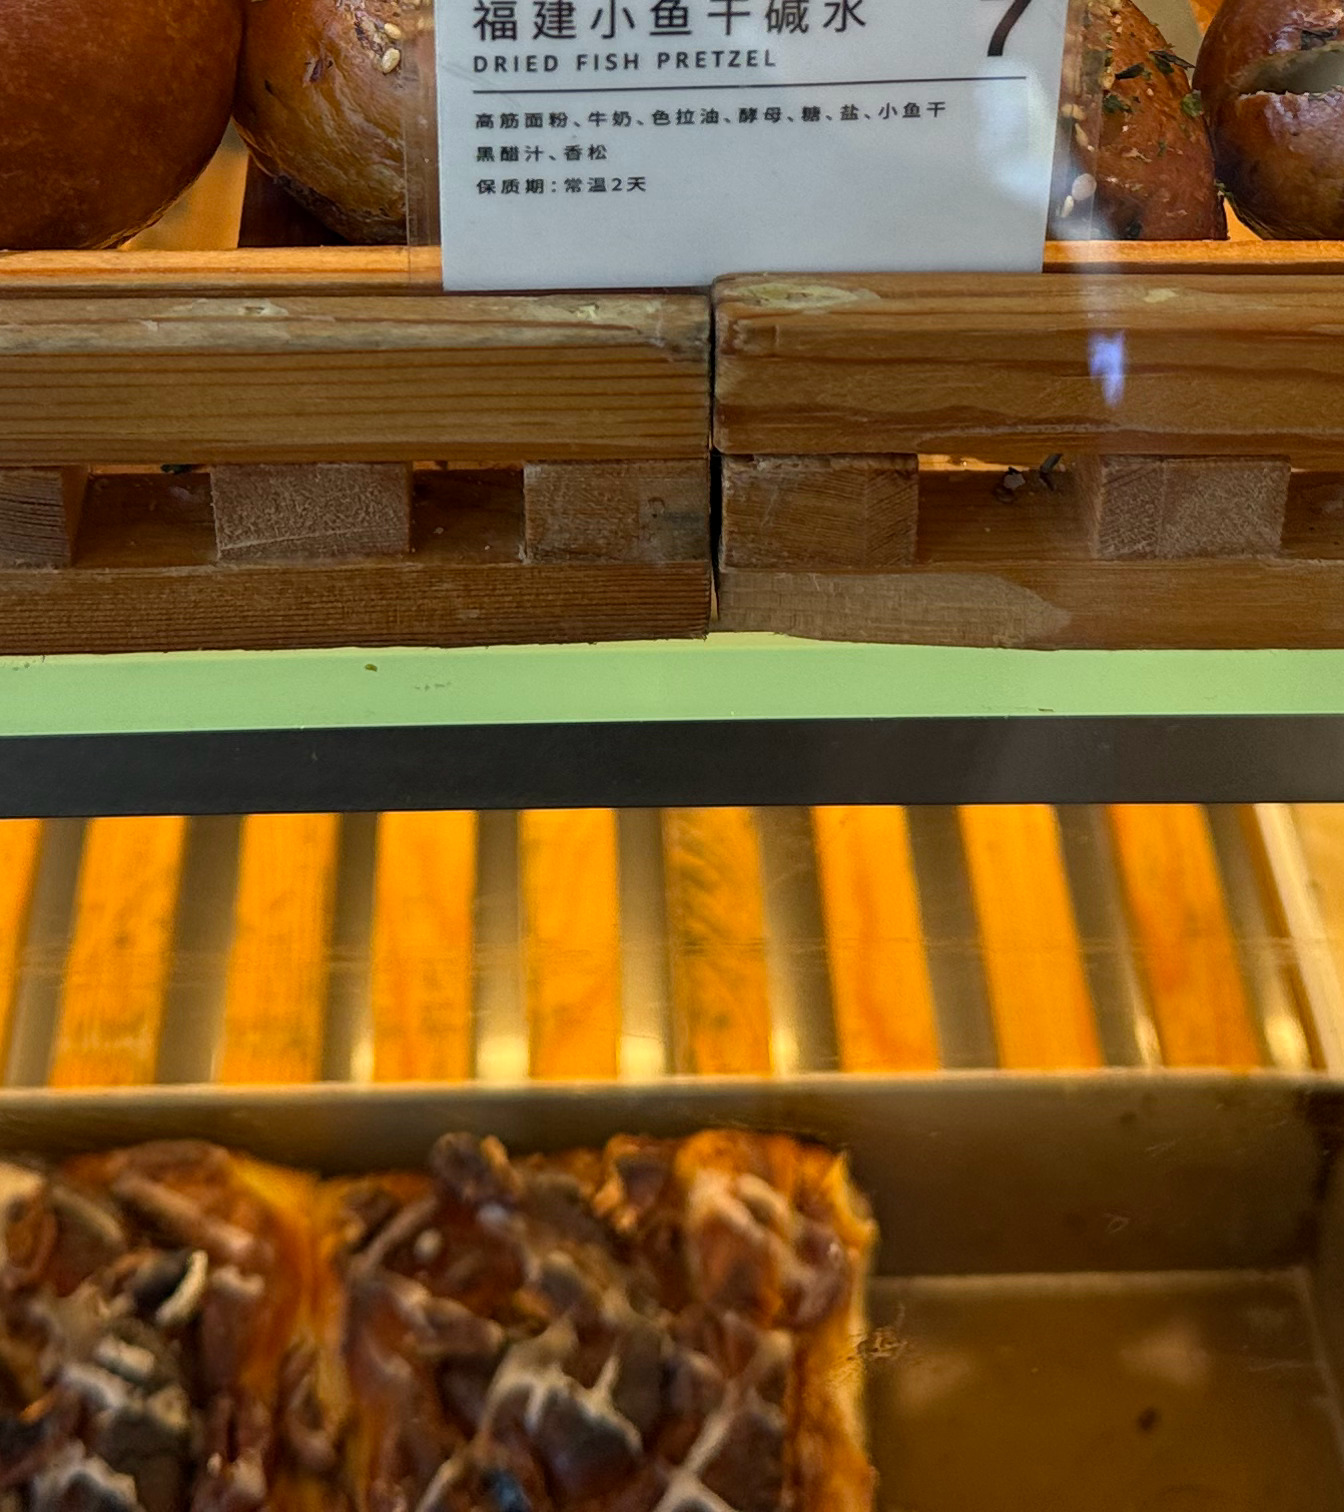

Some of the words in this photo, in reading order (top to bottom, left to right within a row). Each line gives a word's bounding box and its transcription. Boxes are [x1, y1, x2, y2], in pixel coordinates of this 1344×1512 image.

[474, 55, 558, 73] DRIED
[577, 53, 639, 71] FISH
[657, 50, 776, 69] PRETZEL
